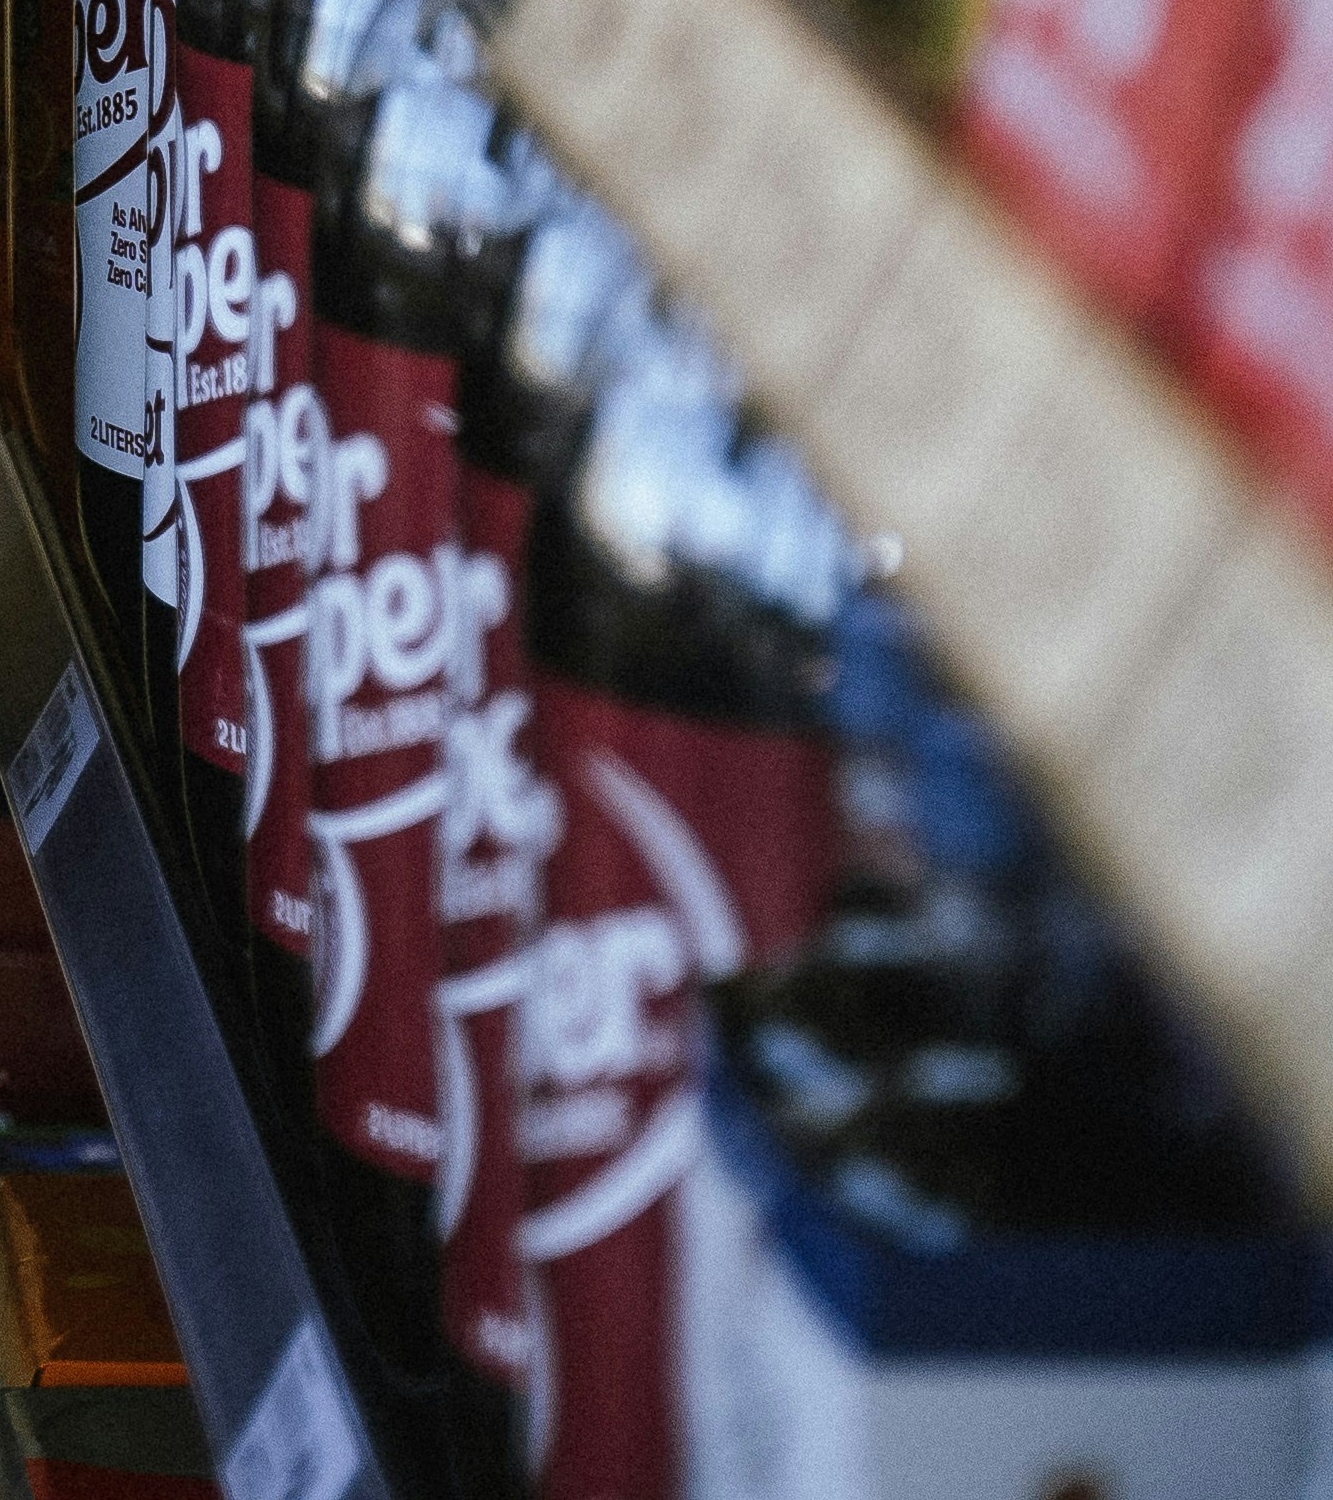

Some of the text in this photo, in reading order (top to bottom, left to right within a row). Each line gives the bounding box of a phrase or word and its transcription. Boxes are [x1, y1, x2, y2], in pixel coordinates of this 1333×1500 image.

[112, 202, 126, 228] As
[111, 231, 136, 260] Zero
[107, 259, 132, 288] Zero
[99, 419, 145, 457] LITERS
